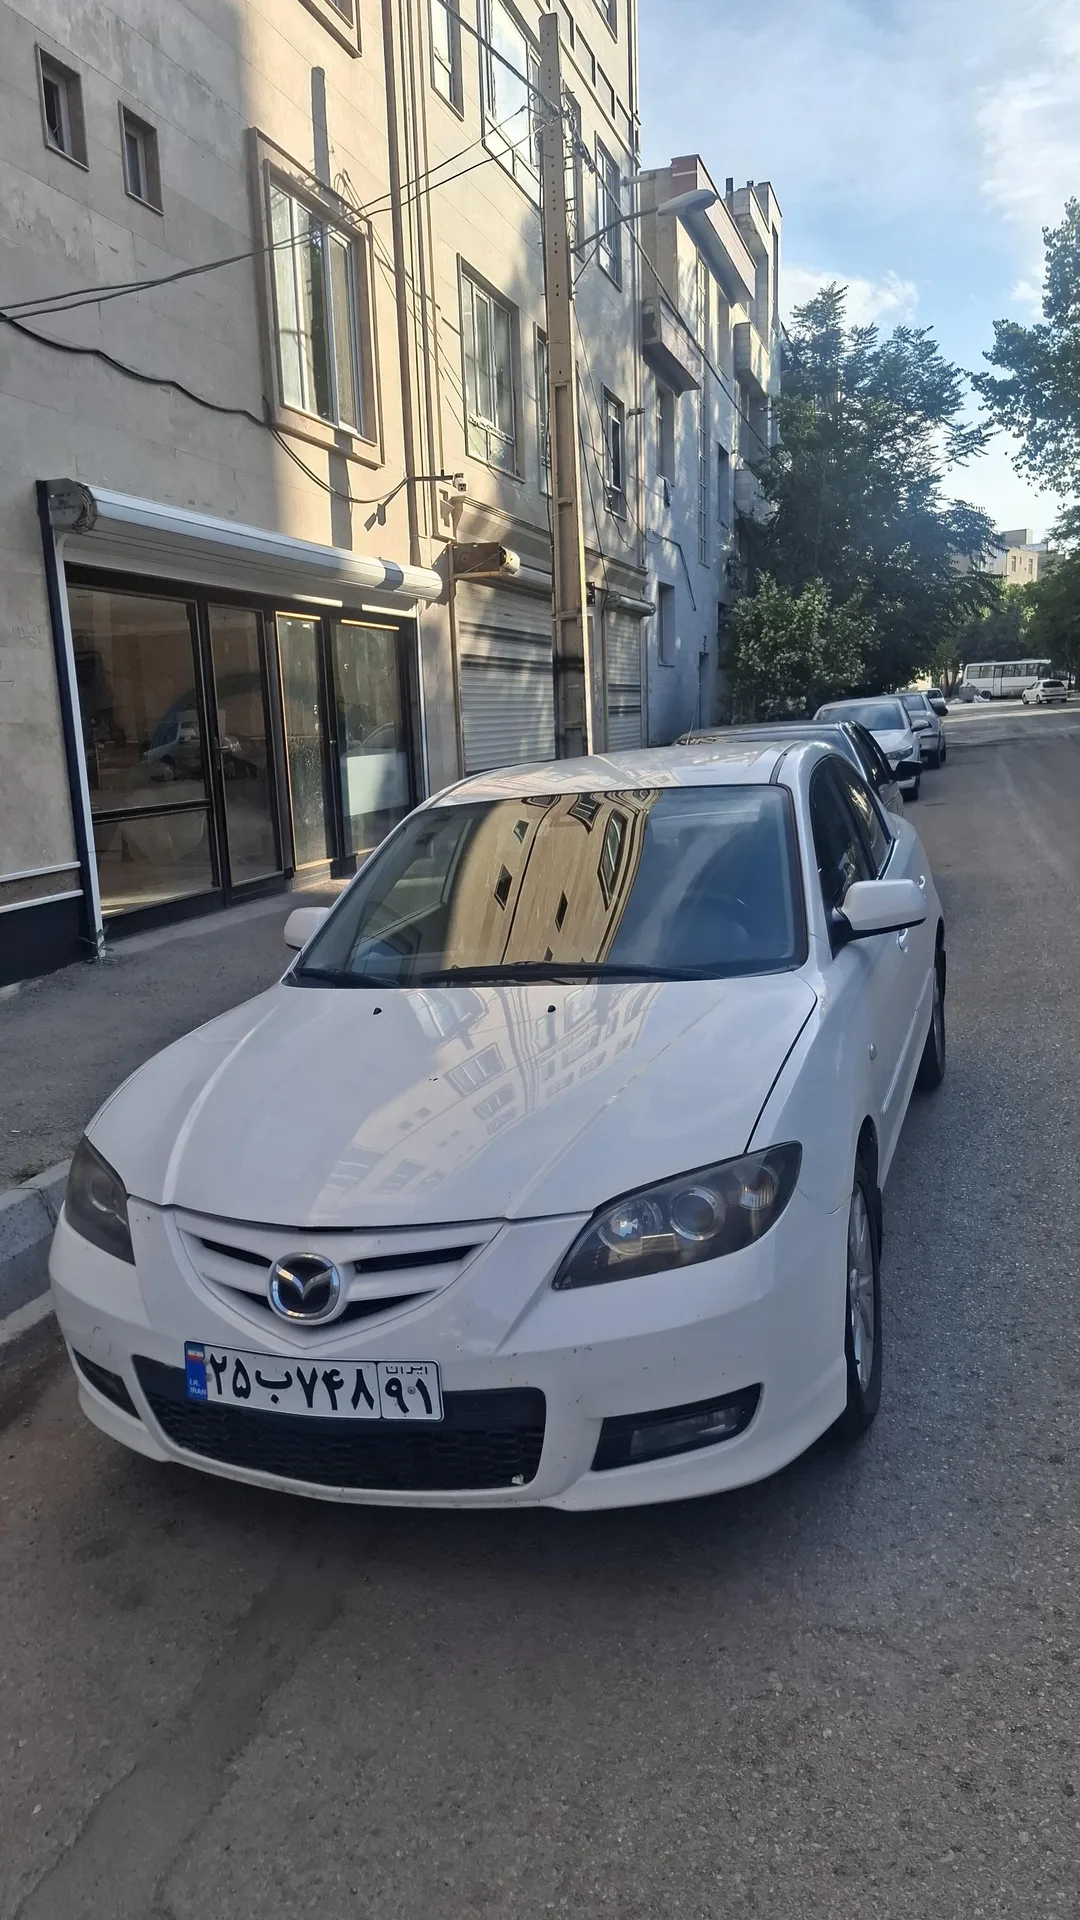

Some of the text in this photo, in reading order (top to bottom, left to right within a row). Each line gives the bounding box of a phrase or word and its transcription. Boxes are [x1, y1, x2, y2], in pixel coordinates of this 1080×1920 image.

[386, 1365, 428, 1375] ایران
[189, 1386, 207, 1396] IRAN
[385, 1377, 433, 1415] ۹۱
